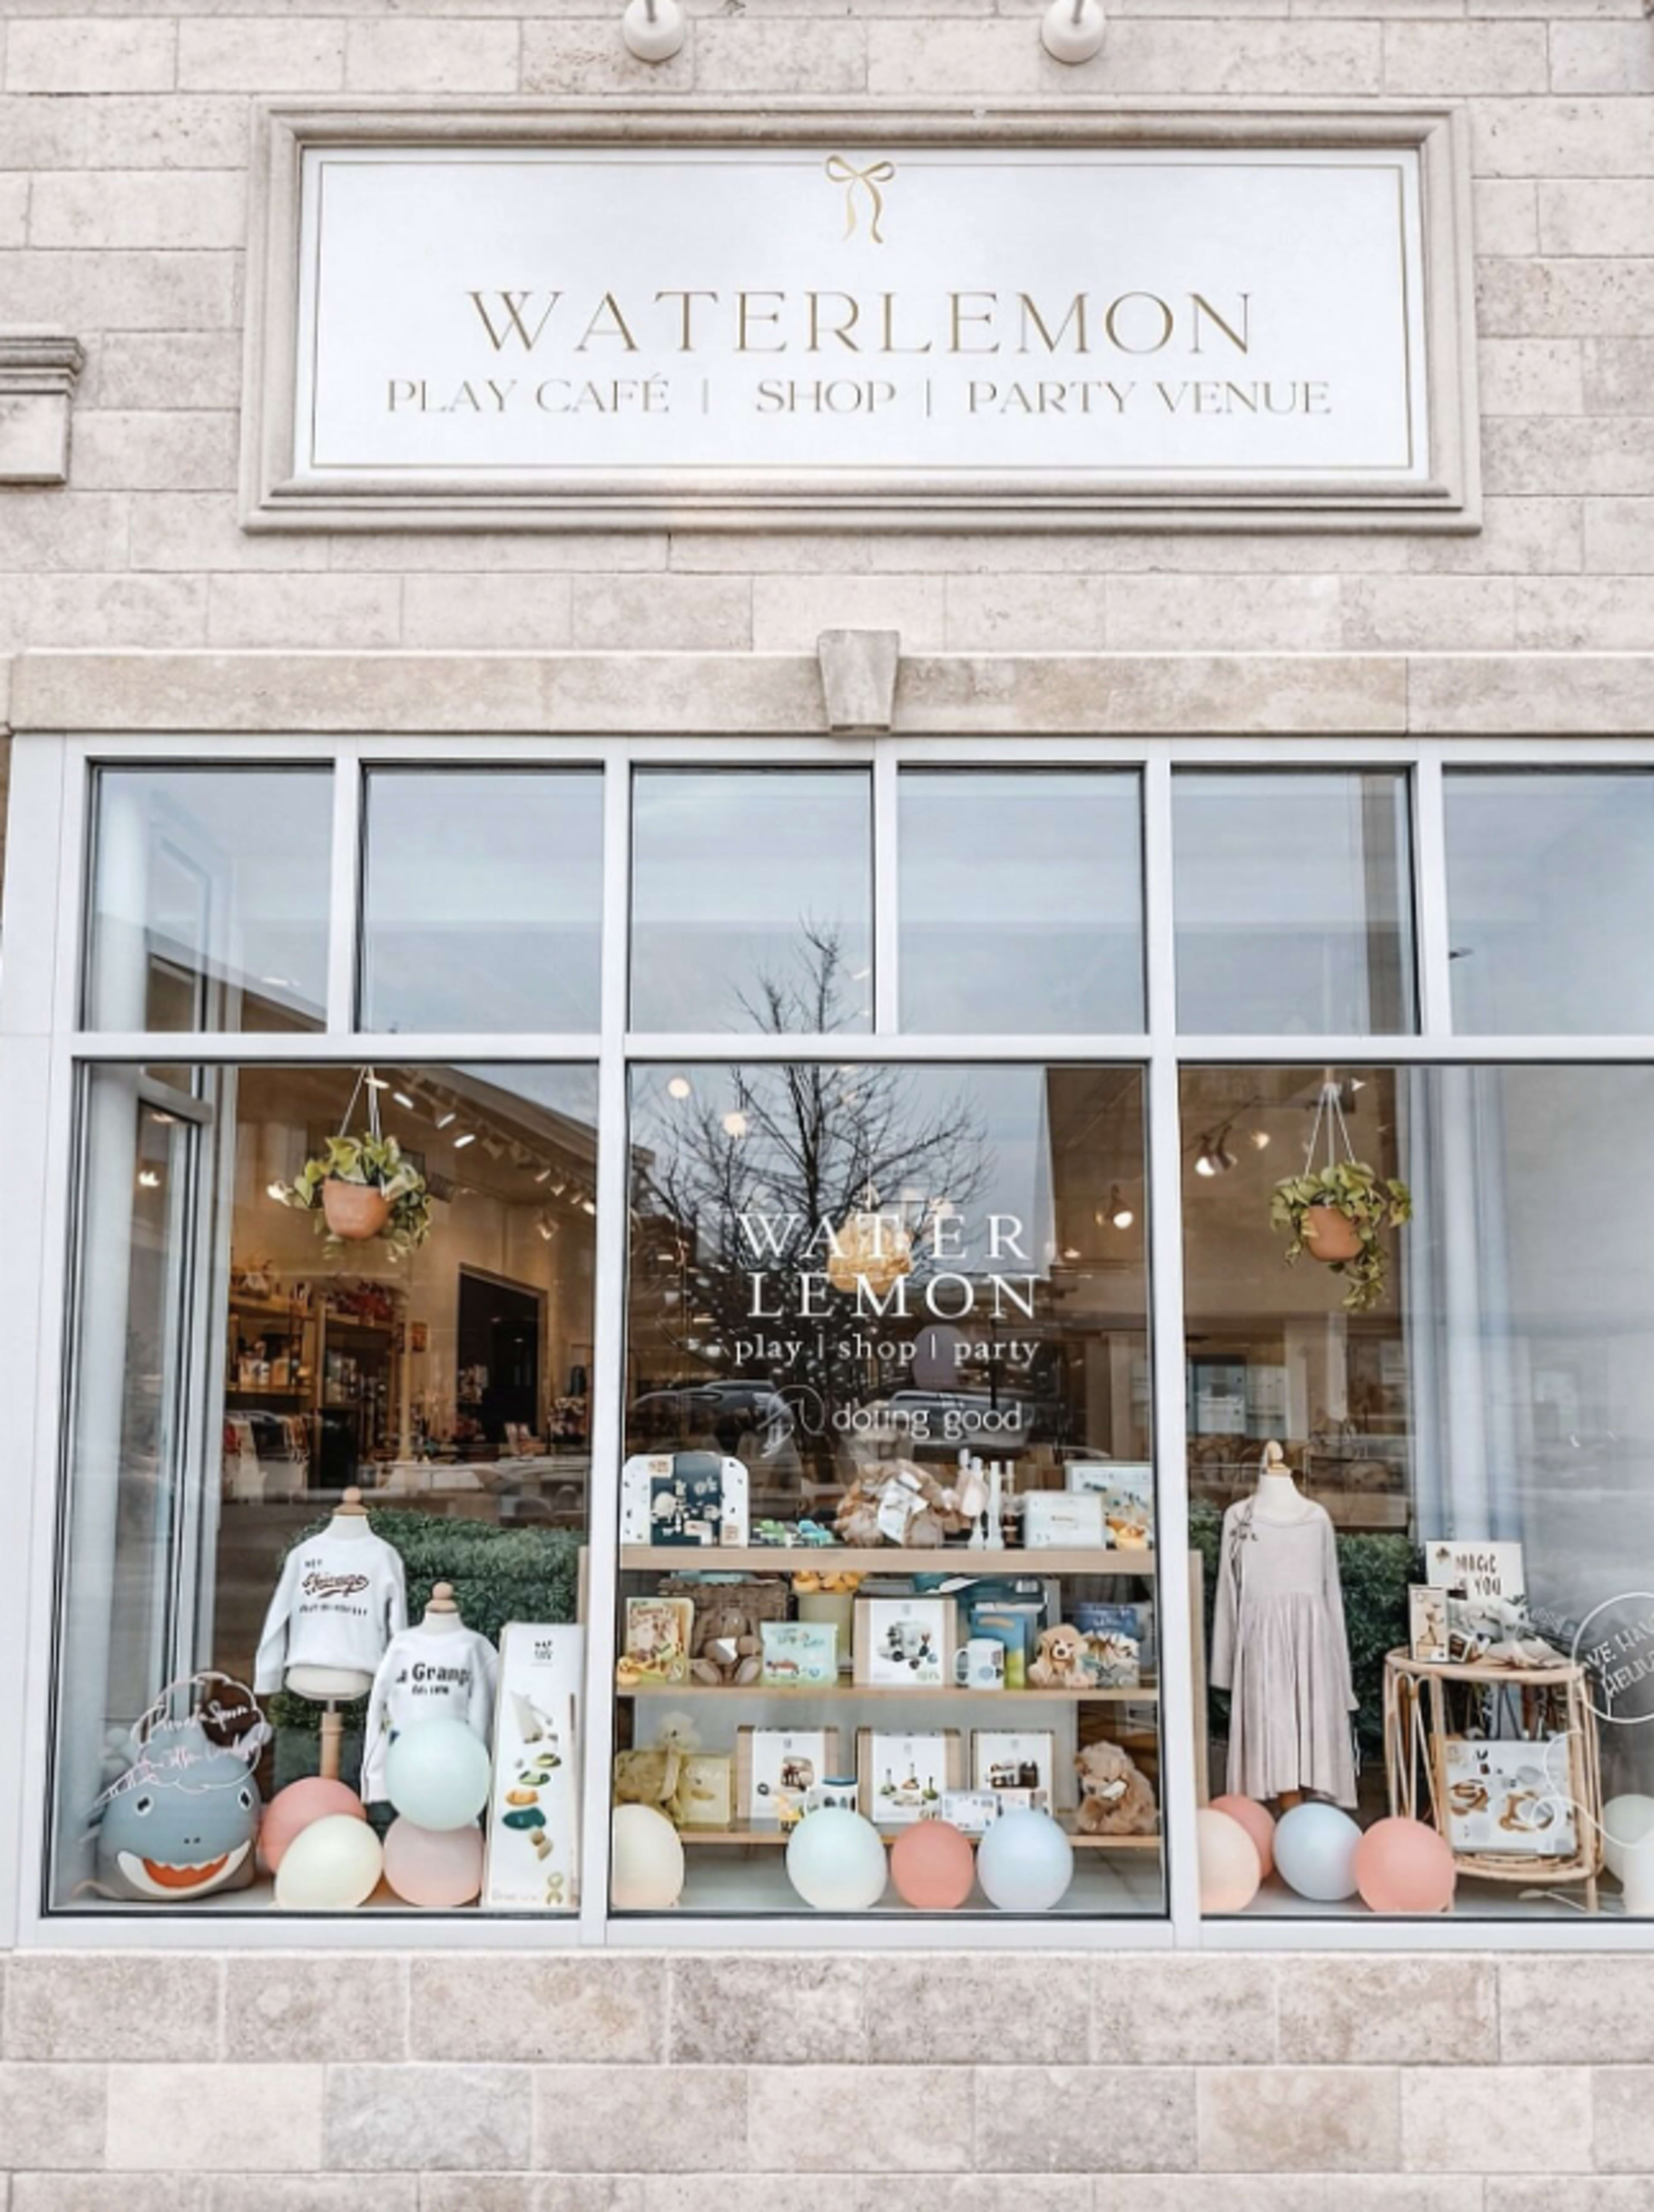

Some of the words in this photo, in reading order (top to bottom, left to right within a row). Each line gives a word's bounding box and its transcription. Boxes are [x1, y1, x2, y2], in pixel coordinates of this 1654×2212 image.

[465, 290, 1251, 355] WATERLEMON
[388, 379, 517, 413] PLAY
[535, 373, 670, 413] CAFÉ
[755, 380, 896, 413] SHOP
[968, 380, 1136, 414] PARTY
[1155, 380, 1332, 415] VENUE
[737, 1212, 1031, 1260] WATER
[746, 1272, 1040, 1319] LEMON
[734, 1333, 803, 1367] play
[837, 1333, 917, 1366] shop
[953, 1336, 1040, 1368] party
[943, 1401, 1023, 1440] good
